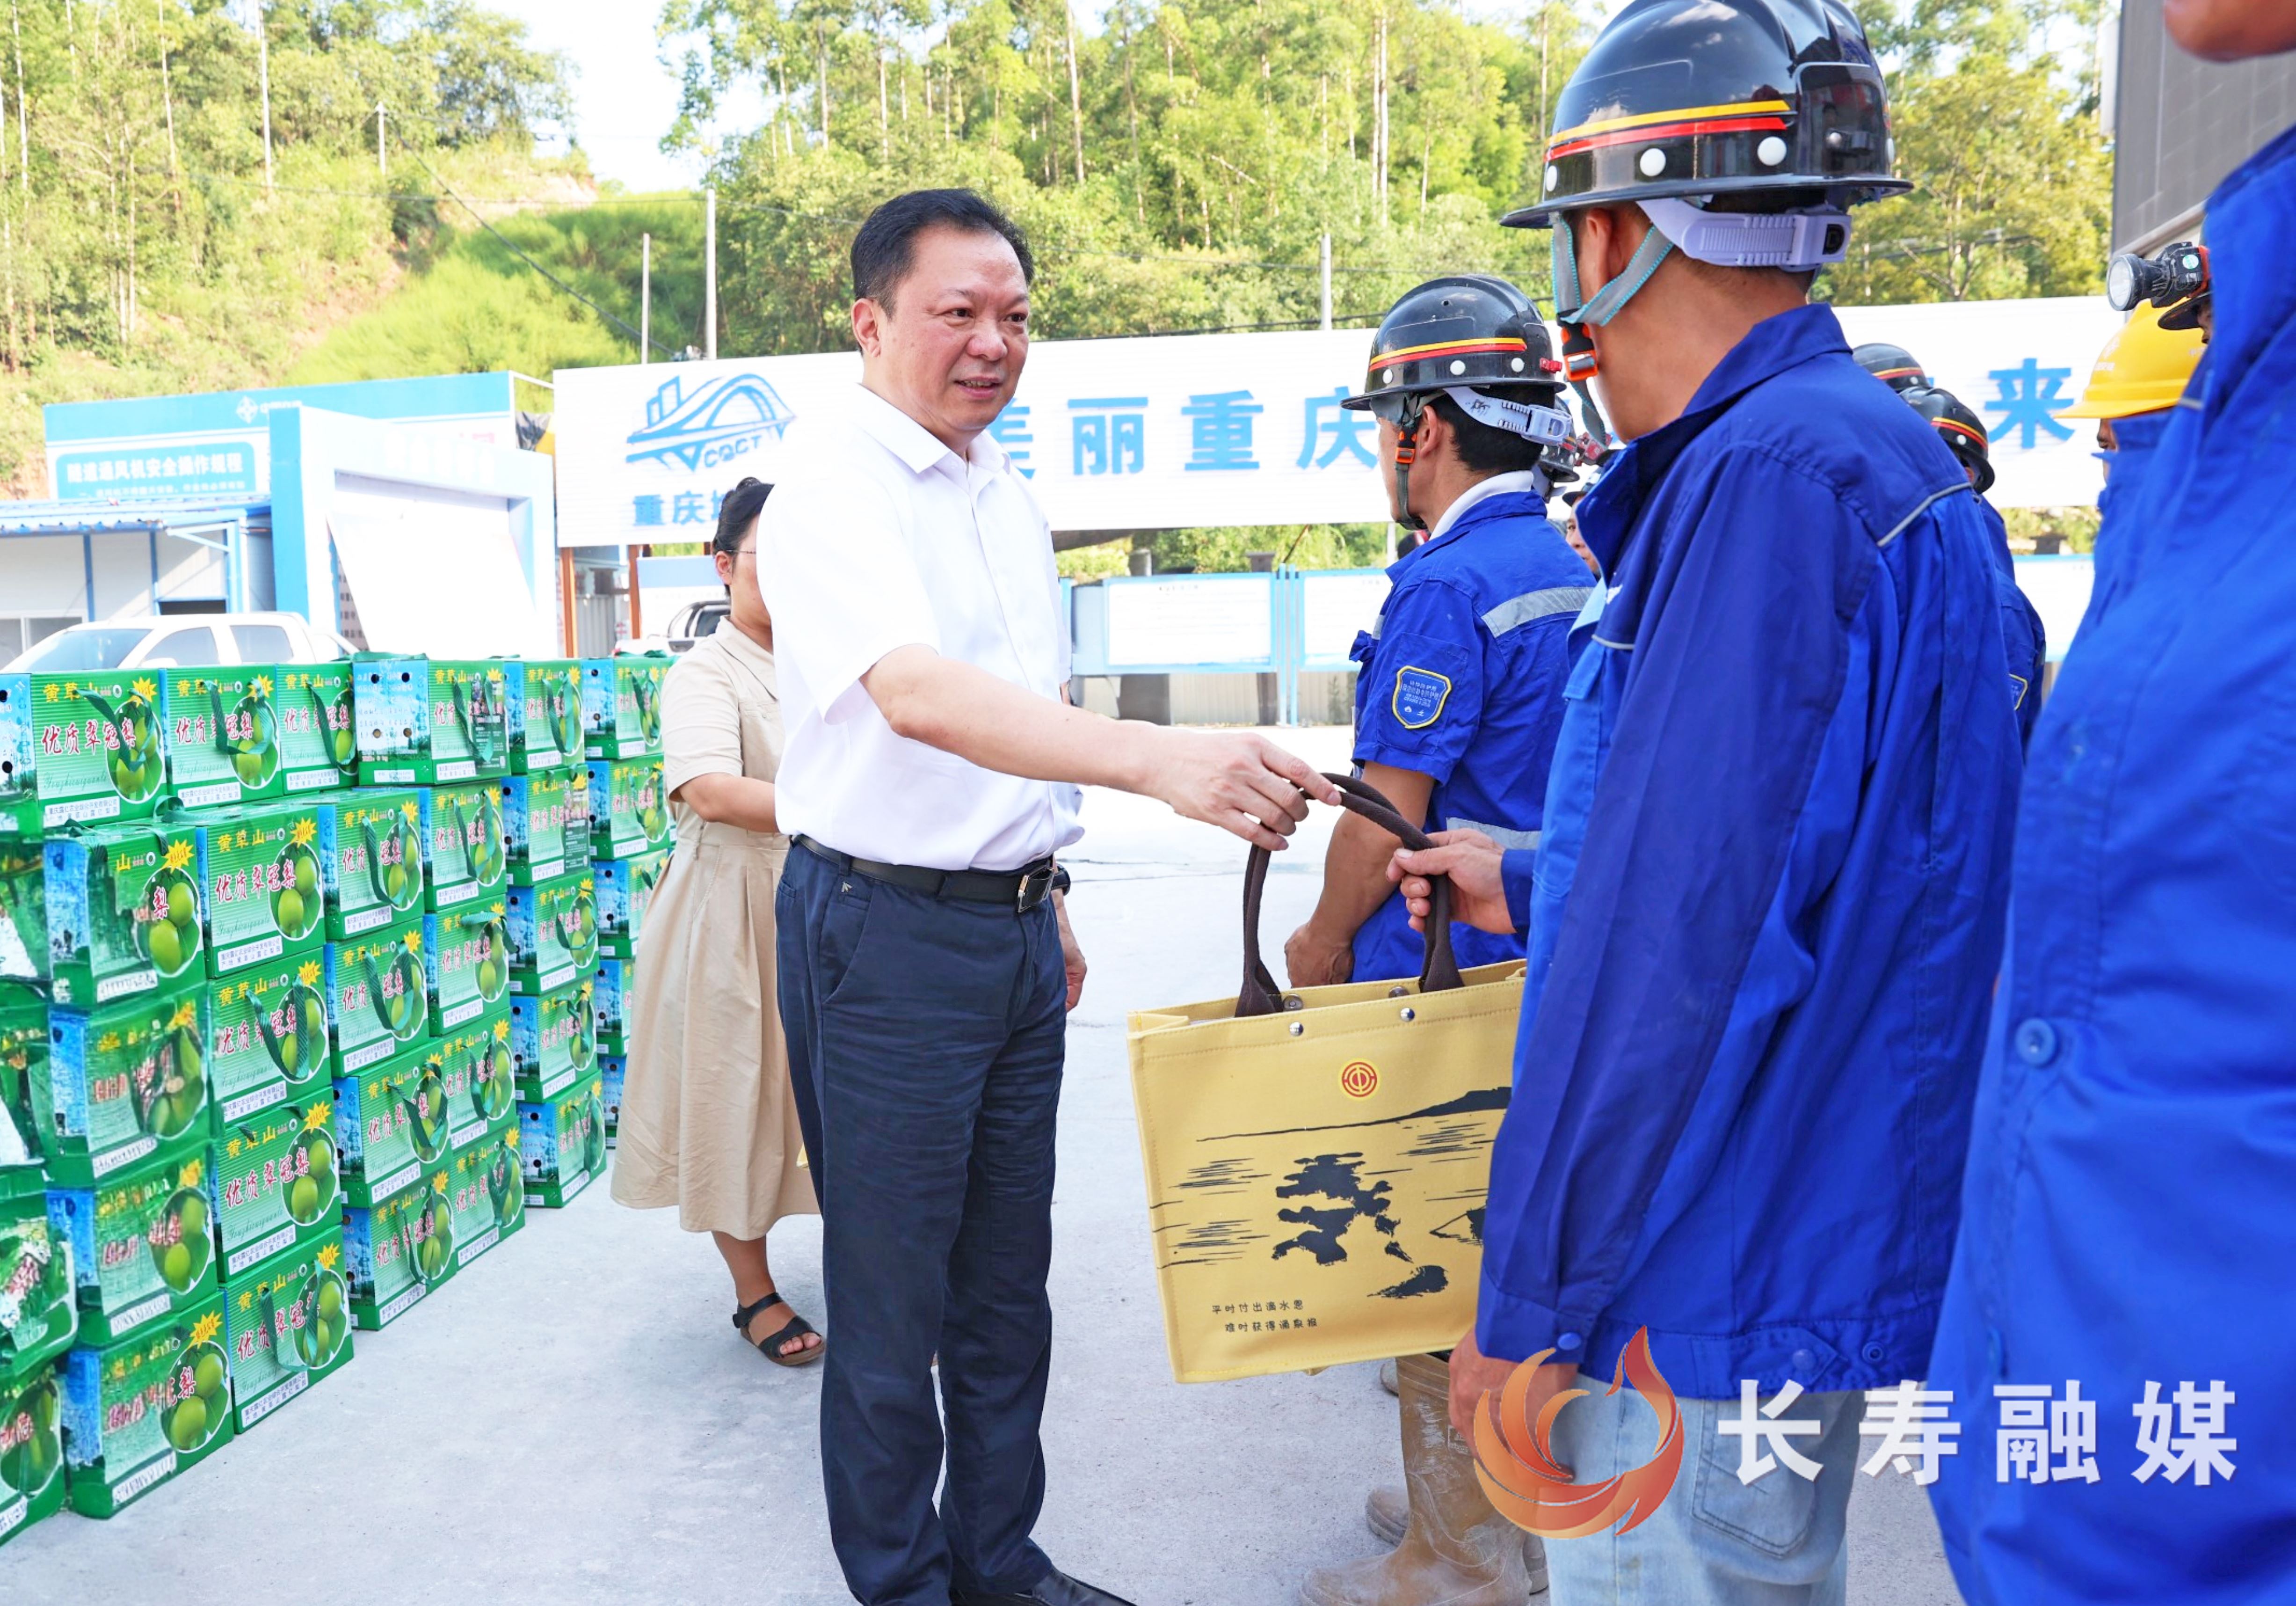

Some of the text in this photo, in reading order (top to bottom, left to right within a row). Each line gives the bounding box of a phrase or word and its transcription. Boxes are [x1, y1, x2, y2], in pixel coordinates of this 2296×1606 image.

[1984, 358, 2076, 449] 来
[704, 435, 762, 468] CQCT
[217, 829, 265, 853] 黄草山
[342, 837, 401, 873] 优质冠梨
[215, 858, 297, 904] 优质翠冠梨
[342, 968, 404, 1011] 优质冠梨
[367, 1092, 429, 1145] 优质翠梨
[225, 1146, 310, 1208] 优质翠冠梨
[1212, 1299, 1304, 1314] 平时付出滴水恩
[1225, 1317, 1317, 1332] 难时获得涌泉报
